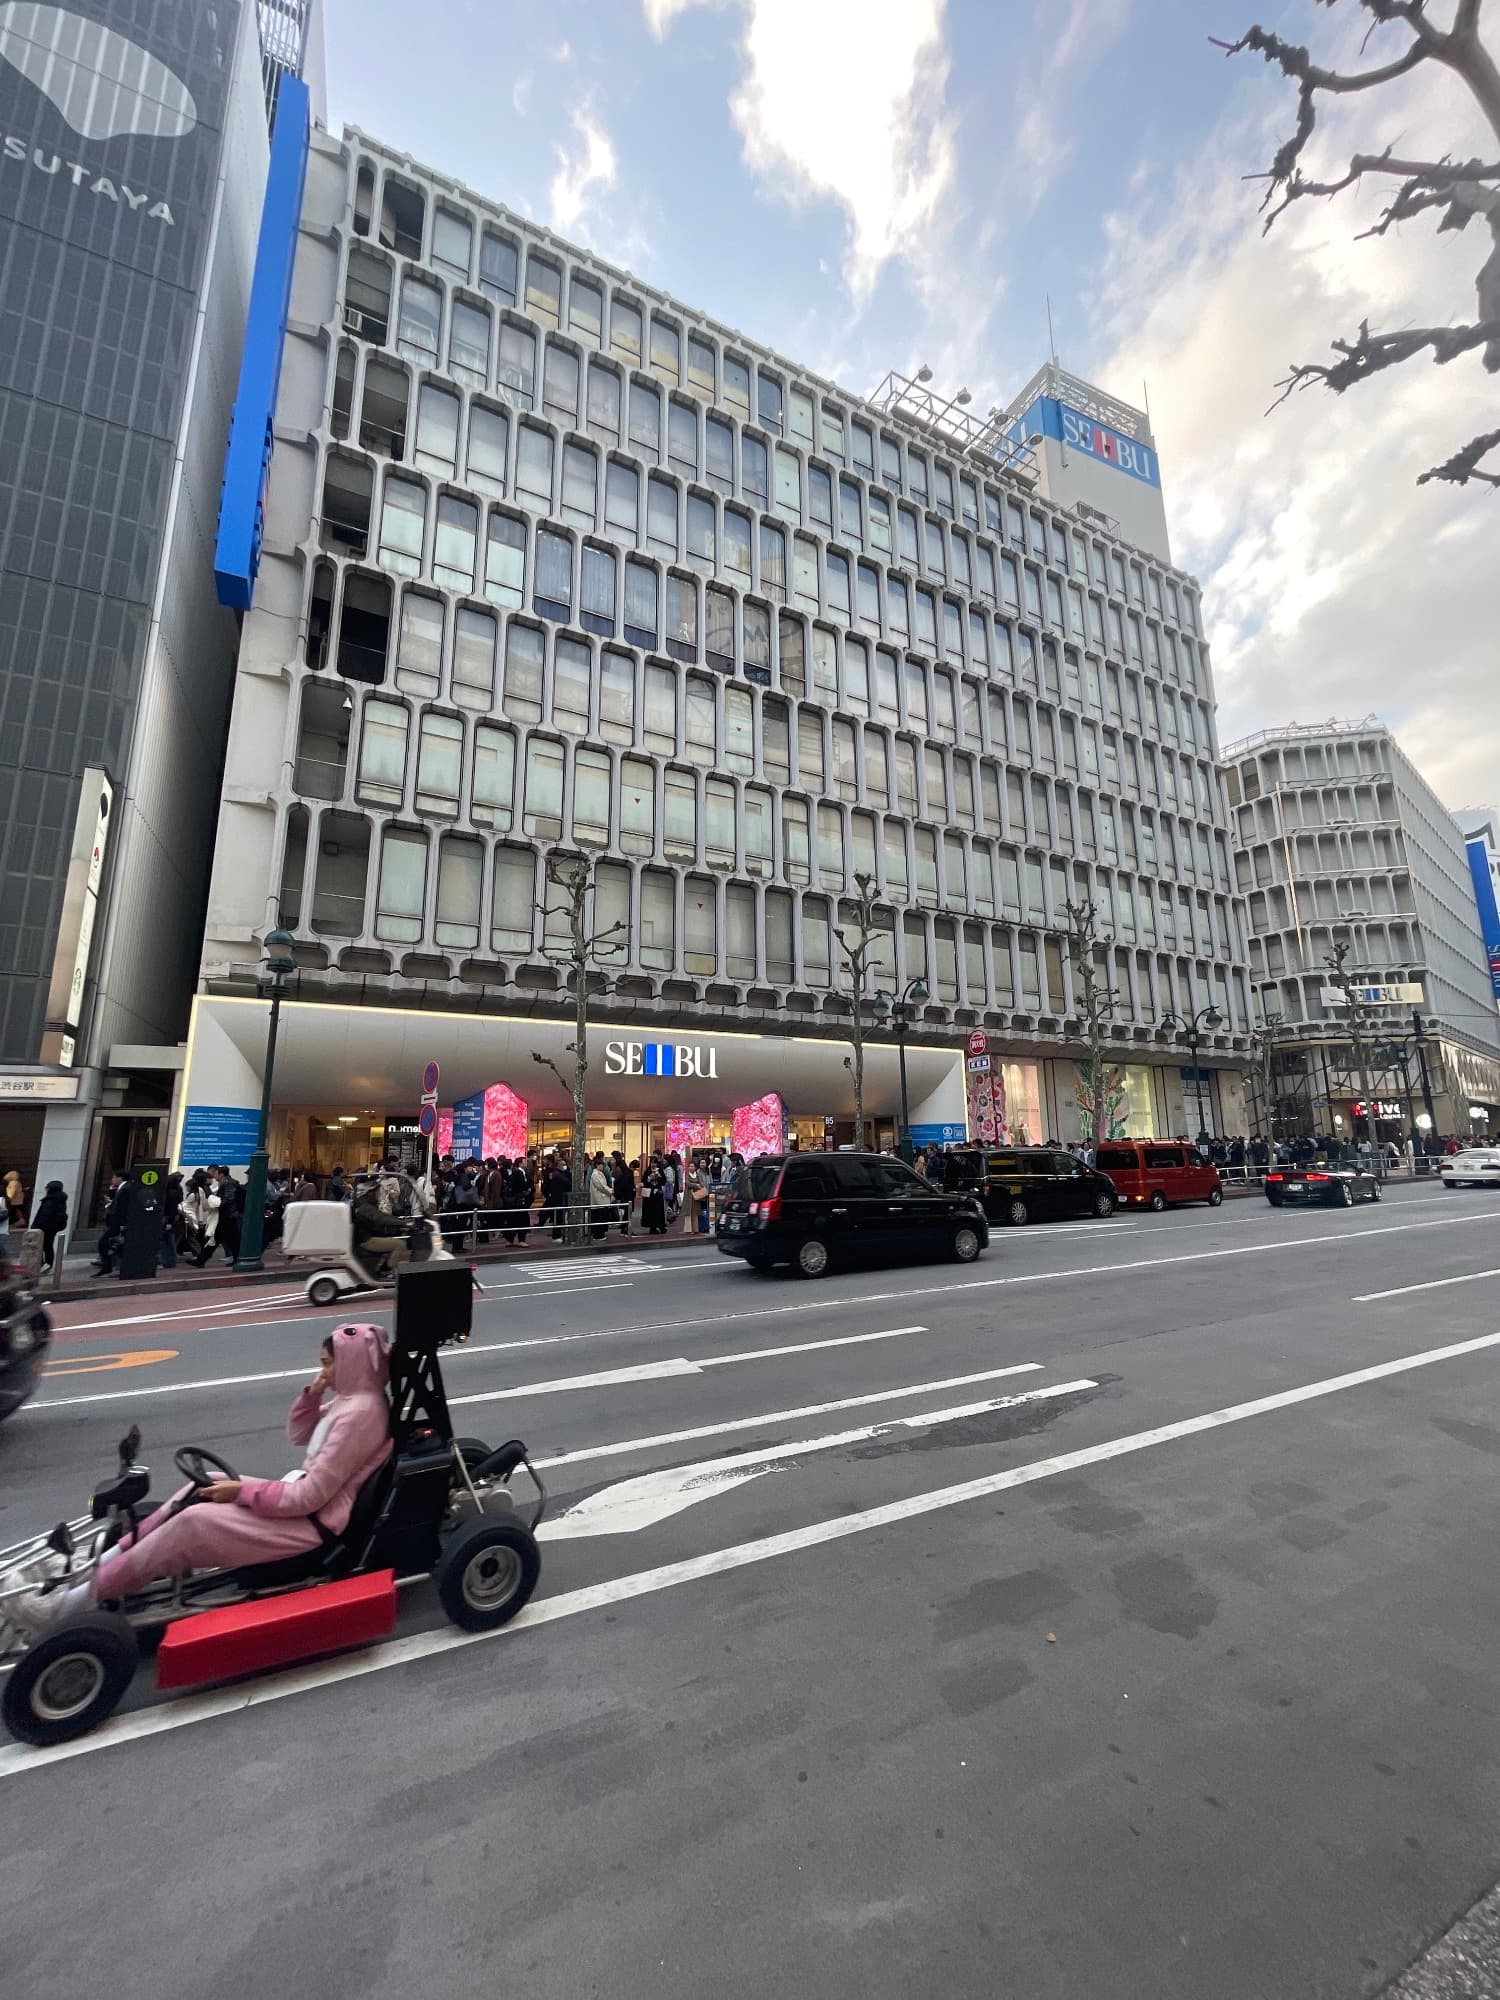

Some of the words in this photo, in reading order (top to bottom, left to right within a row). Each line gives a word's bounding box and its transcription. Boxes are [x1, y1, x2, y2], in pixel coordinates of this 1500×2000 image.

[0, 130, 176, 226] SUTAYA
[1062, 413, 1151, 480] SEIBU
[605, 1041, 719, 1078] SEIBU
